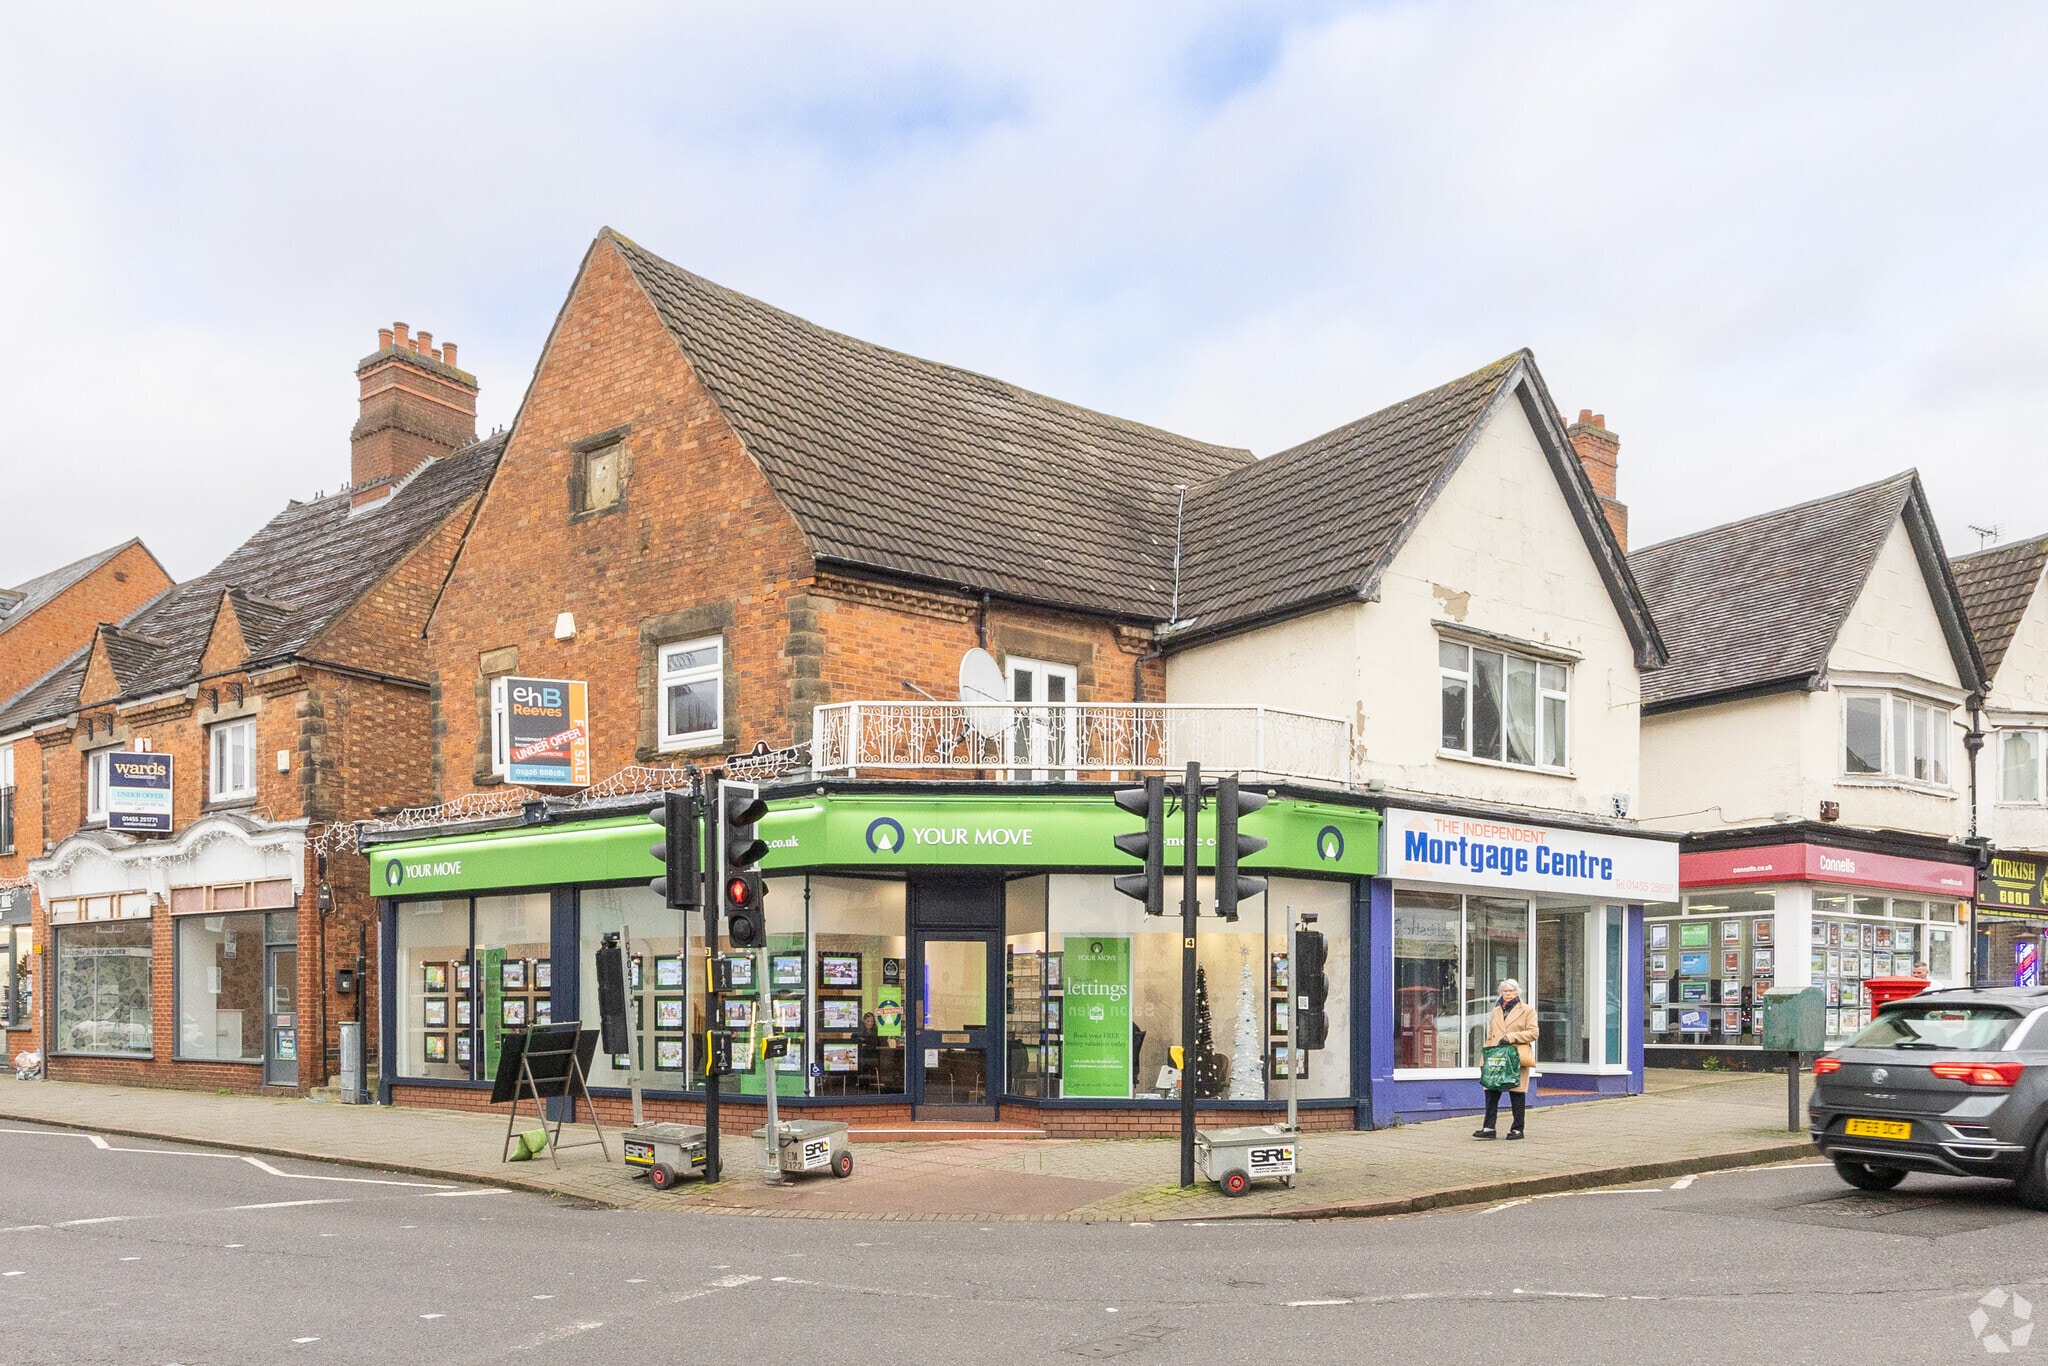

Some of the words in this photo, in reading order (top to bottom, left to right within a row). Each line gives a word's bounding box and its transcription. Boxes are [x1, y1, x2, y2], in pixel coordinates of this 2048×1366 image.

[513, 687, 562, 708] ehB
[513, 704, 563, 717] Reeves
[573, 719, 584, 746] FR
[515, 740, 549, 761] UNDER
[549, 728, 582, 747] OFFER
[114, 762, 167, 776] wards
[515, 768, 538, 776] 01926
[574, 749, 586, 783] SALE
[117, 791, 141, 799] UNDER
[912, 828, 968, 846] YOUR
[974, 829, 1033, 846] MOVE
[1434, 818, 1460, 835] THE
[1463, 822, 1547, 845] INDEPENDENT
[1404, 830, 1529, 876] Mortgage
[1535, 845, 1613, 881] Centre
[1820, 854, 1856, 874] Connells
[405, 863, 432, 879] YOUR
[433, 861, 462, 877] MOVE
[1991, 858, 2037, 881] TURKISH
[1186, 938, 1194, 947] 4
[1066, 977, 1128, 1002] lettings
[805, 1140, 829, 1157] SRL
[1250, 1148, 1293, 1163] SRL
[783, 1161, 803, 1170] 7122
